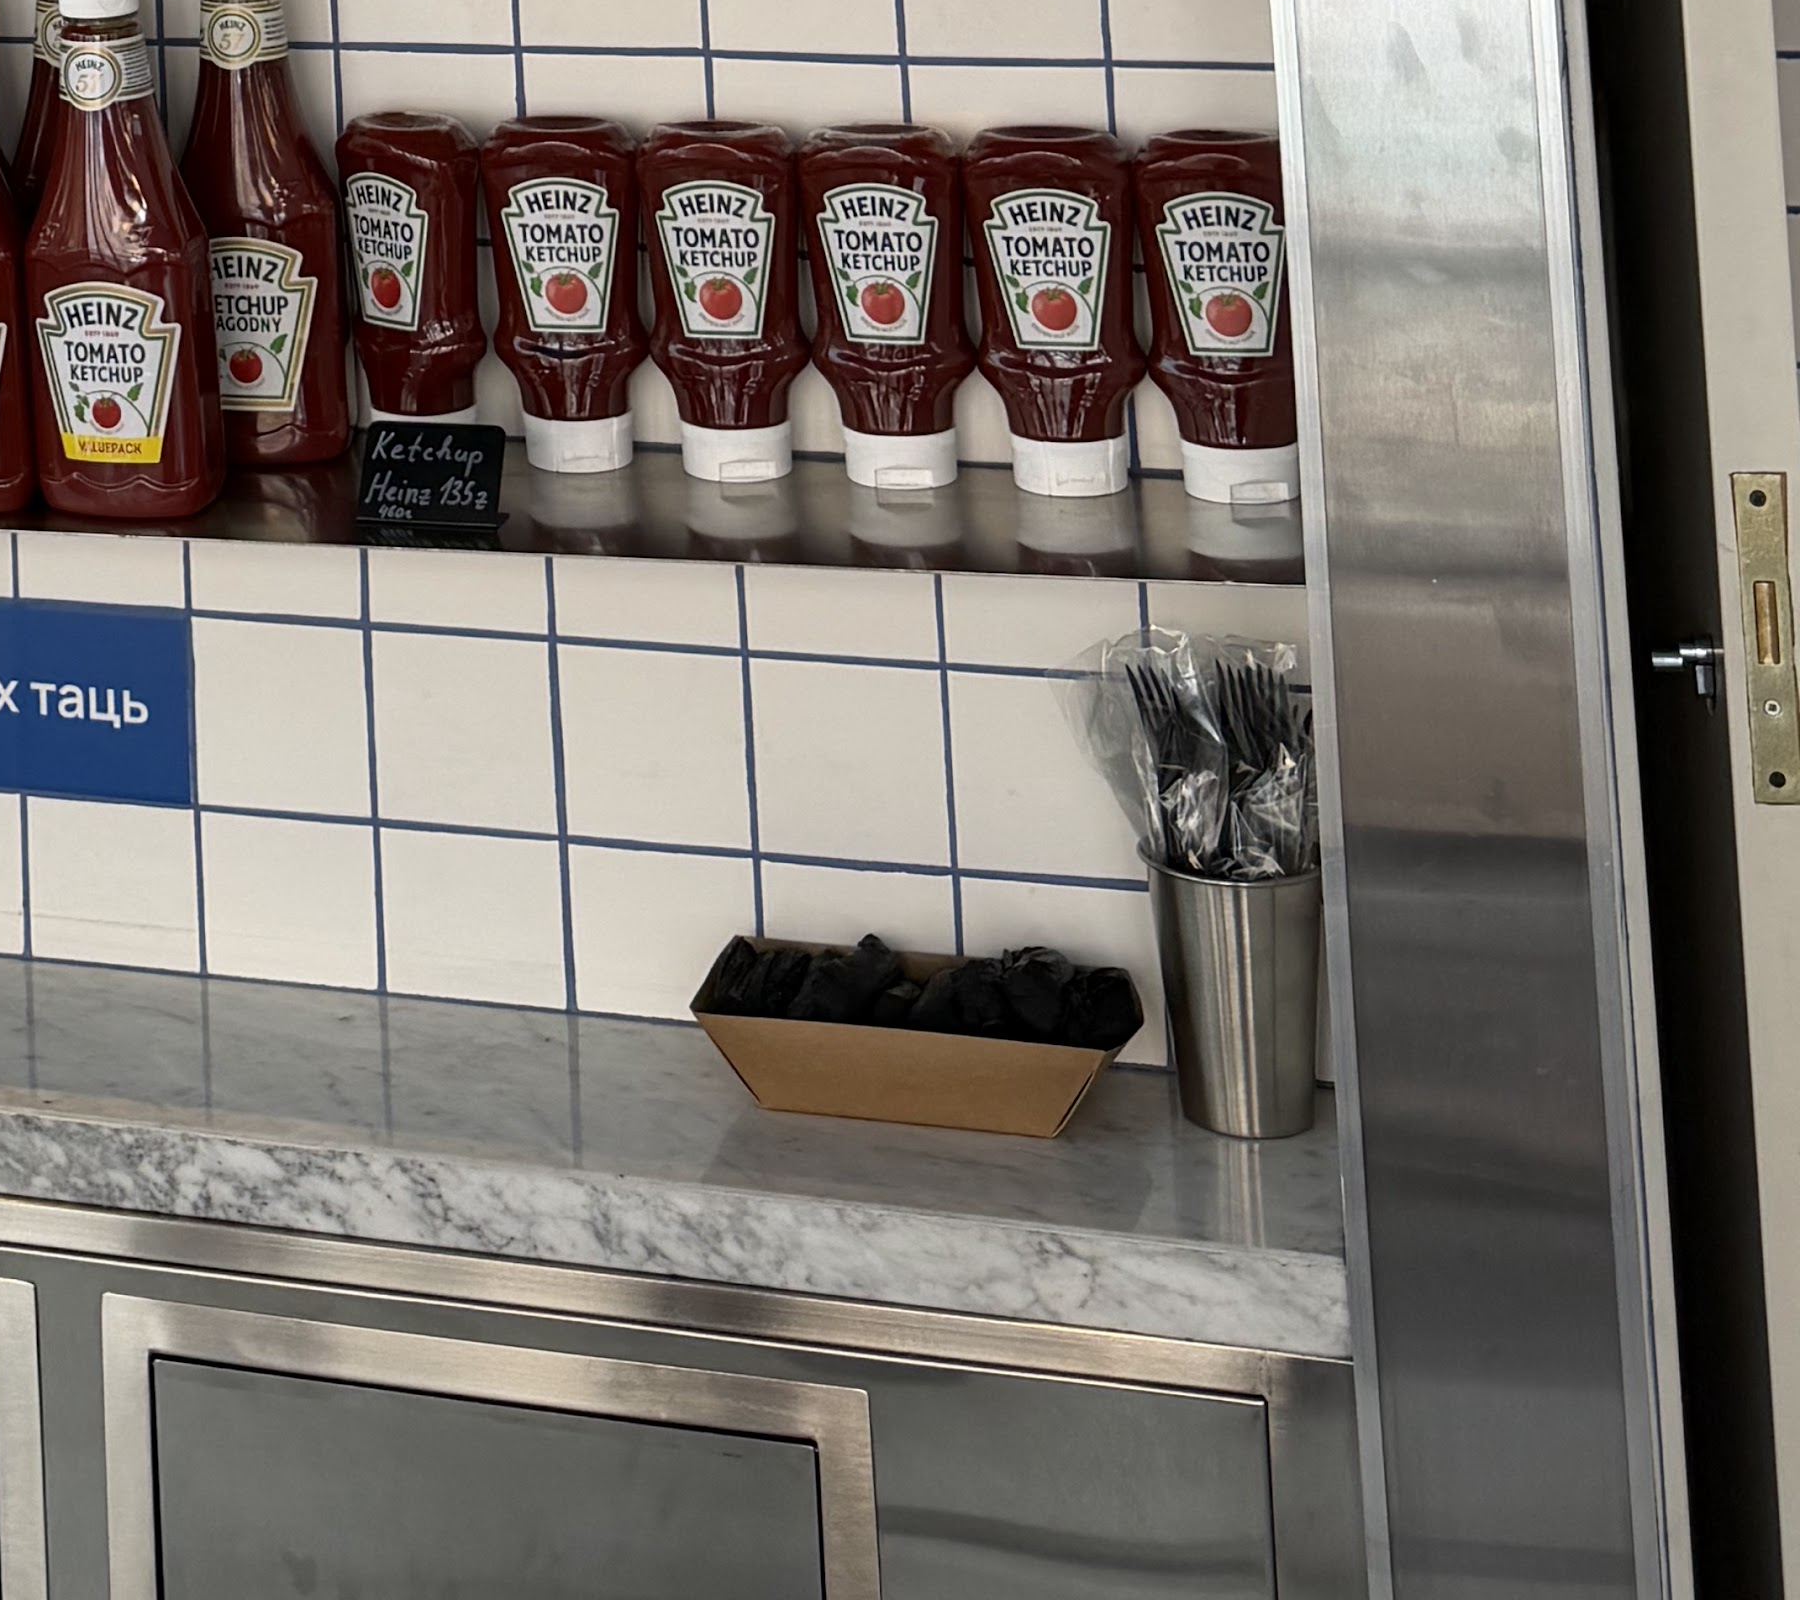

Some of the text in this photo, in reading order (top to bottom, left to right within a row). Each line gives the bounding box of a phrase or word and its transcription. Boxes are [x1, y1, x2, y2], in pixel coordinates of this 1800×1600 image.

[355, 184, 403, 212] HEINZ
[524, 190, 592, 214] HEINZ
[678, 193, 747, 219] HEINZ
[840, 196, 910, 222] HEINZ
[1008, 201, 1081, 227] HEINZ
[1182, 205, 1256, 232] HEINZ
[352, 213, 414, 243] TOMATO
[518, 223, 604, 244] TOMATO
[672, 226, 760, 249] TOMATO
[833, 229, 923, 253] TOMATO
[1001, 236, 1094, 258] TOMATO
[1174, 240, 1270, 263] TOMATO
[525, 246, 602, 263] KETCHUP
[679, 249, 758, 268] KETCHUP
[841, 252, 920, 272] KETCHUP
[1010, 259, 1092, 277] KETCHUP
[1183, 264, 1268, 283] KETCHUP
[64, 302, 138, 331] HEINZ
[214, 294, 289, 315] ETCHUP
[216, 315, 282, 333] AGODNY
[64, 340, 146, 364] TOMATO
[70, 364, 143, 383] KETCHUP
[371, 430, 484, 477] Ketchup
[364, 470, 432, 506] Heinz
[30, 683, 148, 728] таць
